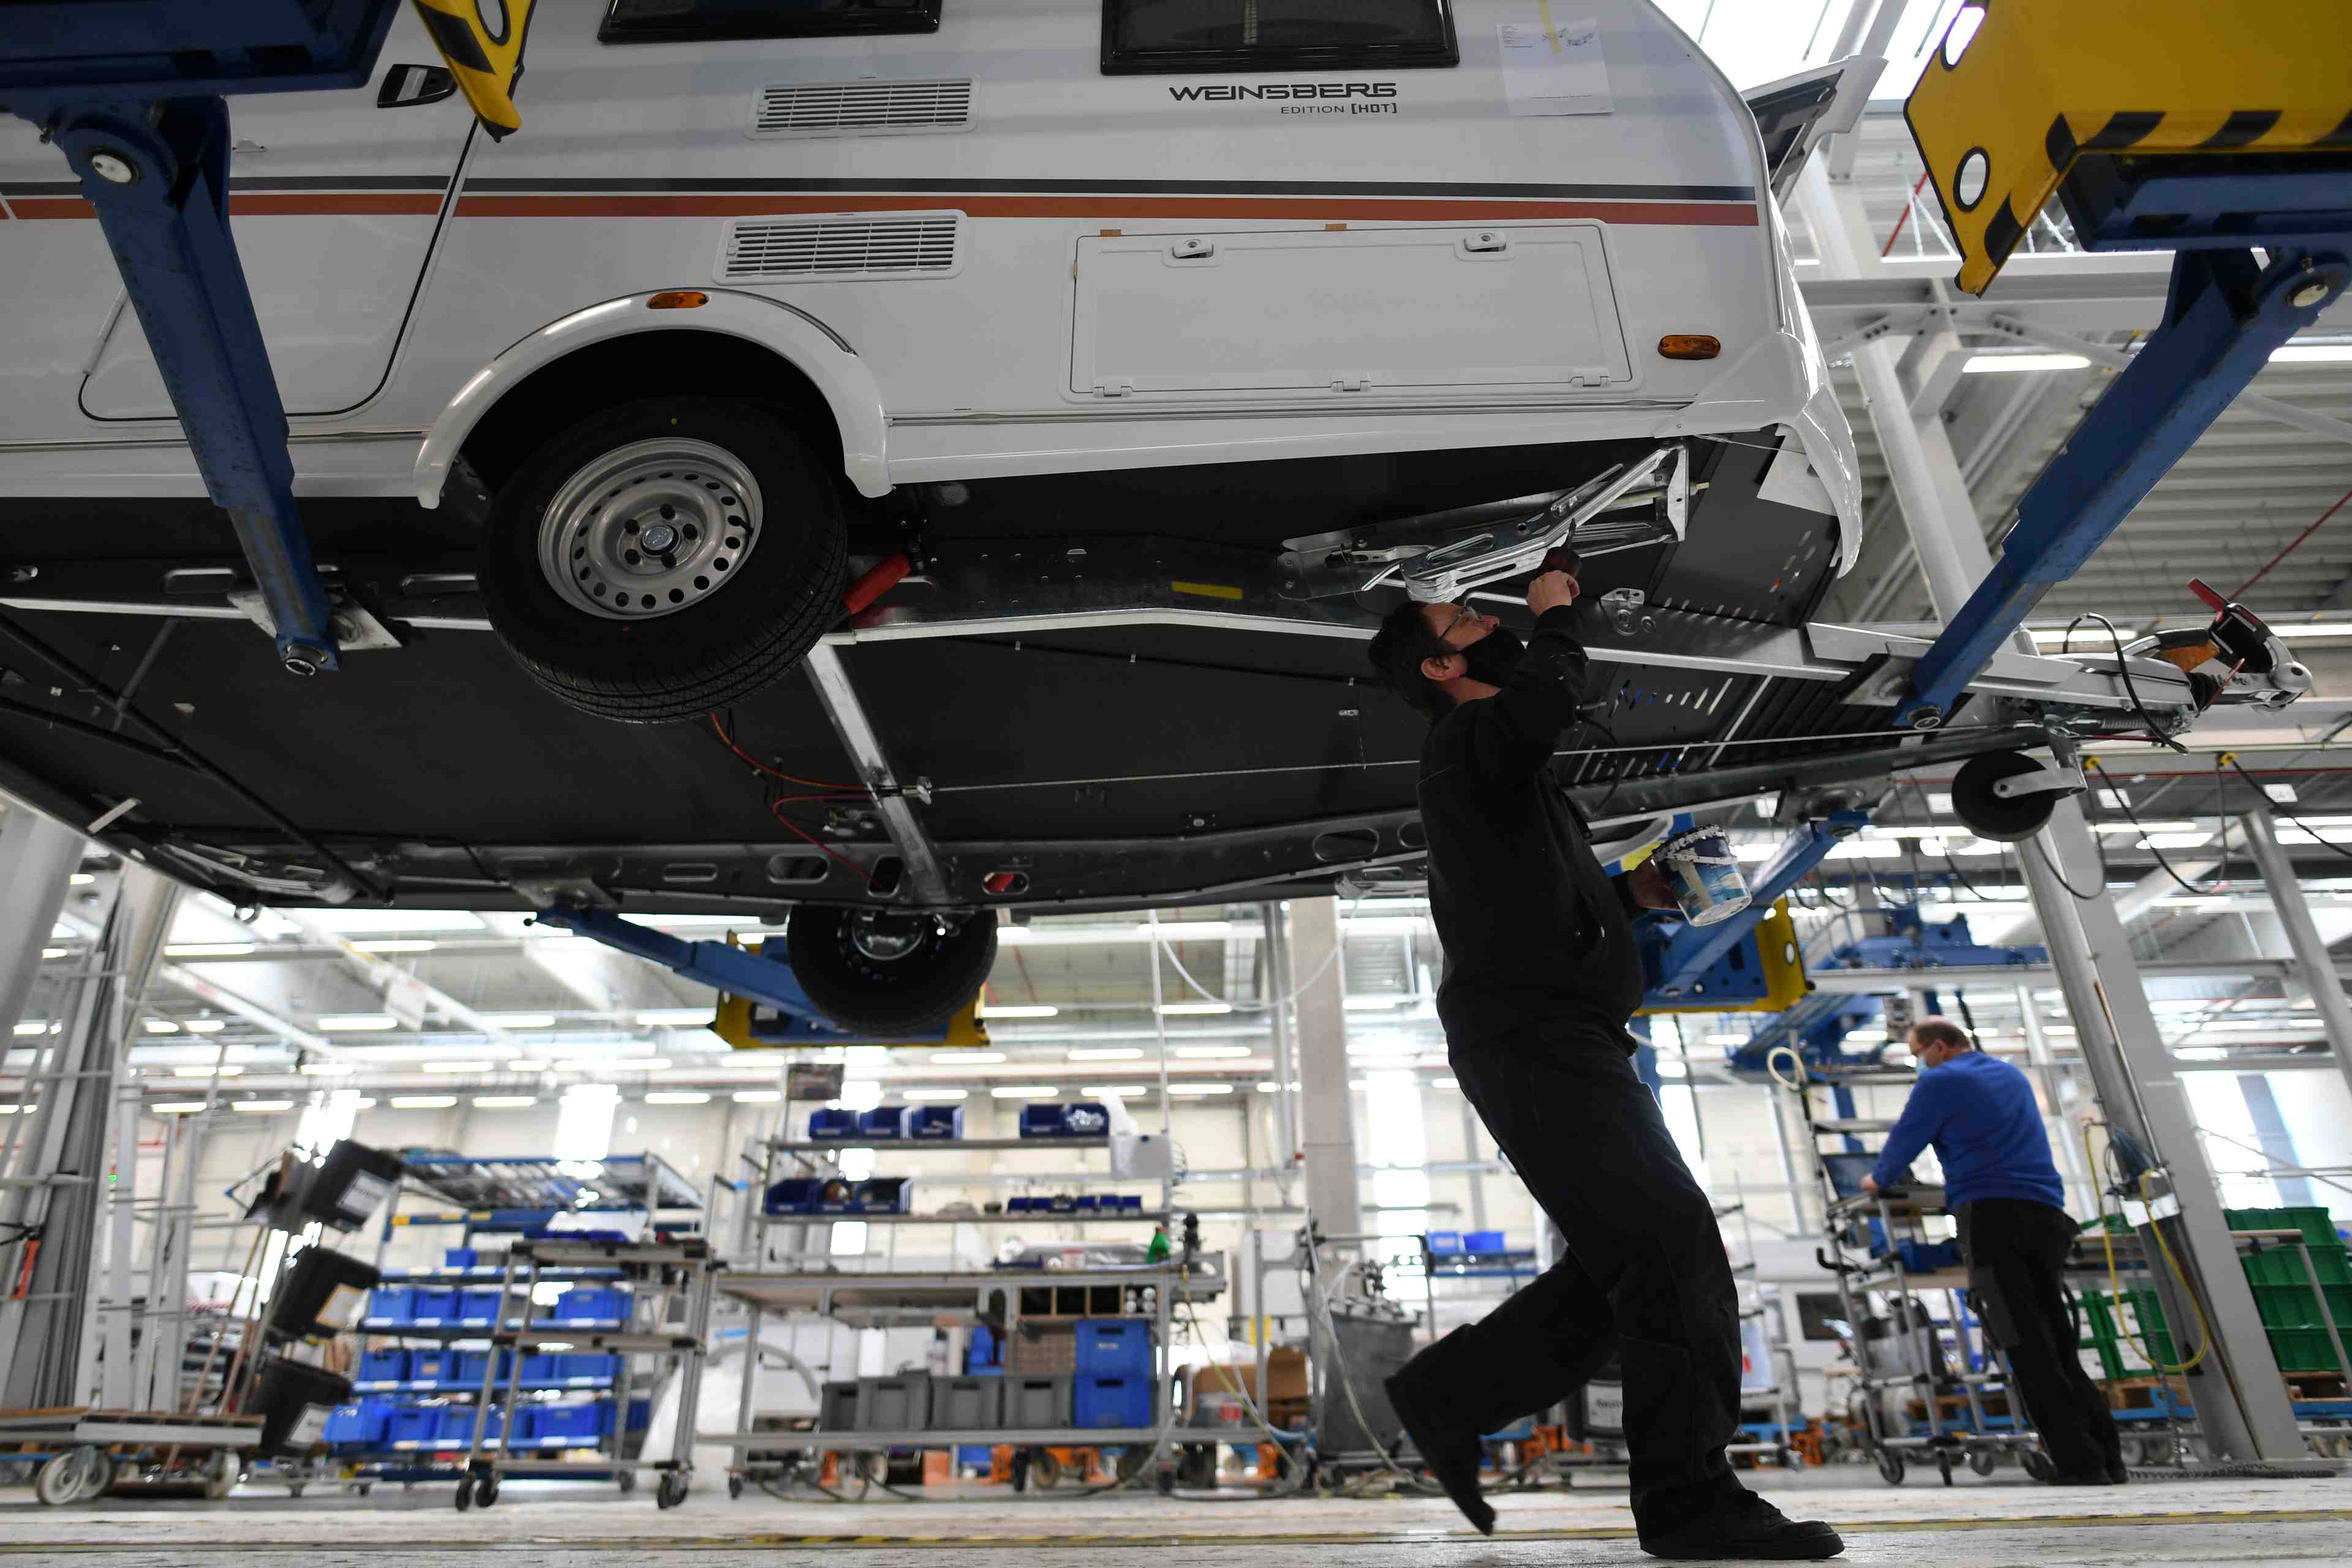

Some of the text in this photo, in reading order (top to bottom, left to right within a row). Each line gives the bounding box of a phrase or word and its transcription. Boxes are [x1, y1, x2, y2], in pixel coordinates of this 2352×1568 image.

[1169, 82, 1397, 101] WEINSBERG
[1280, 102, 1398, 115] EDITION [HOT]
